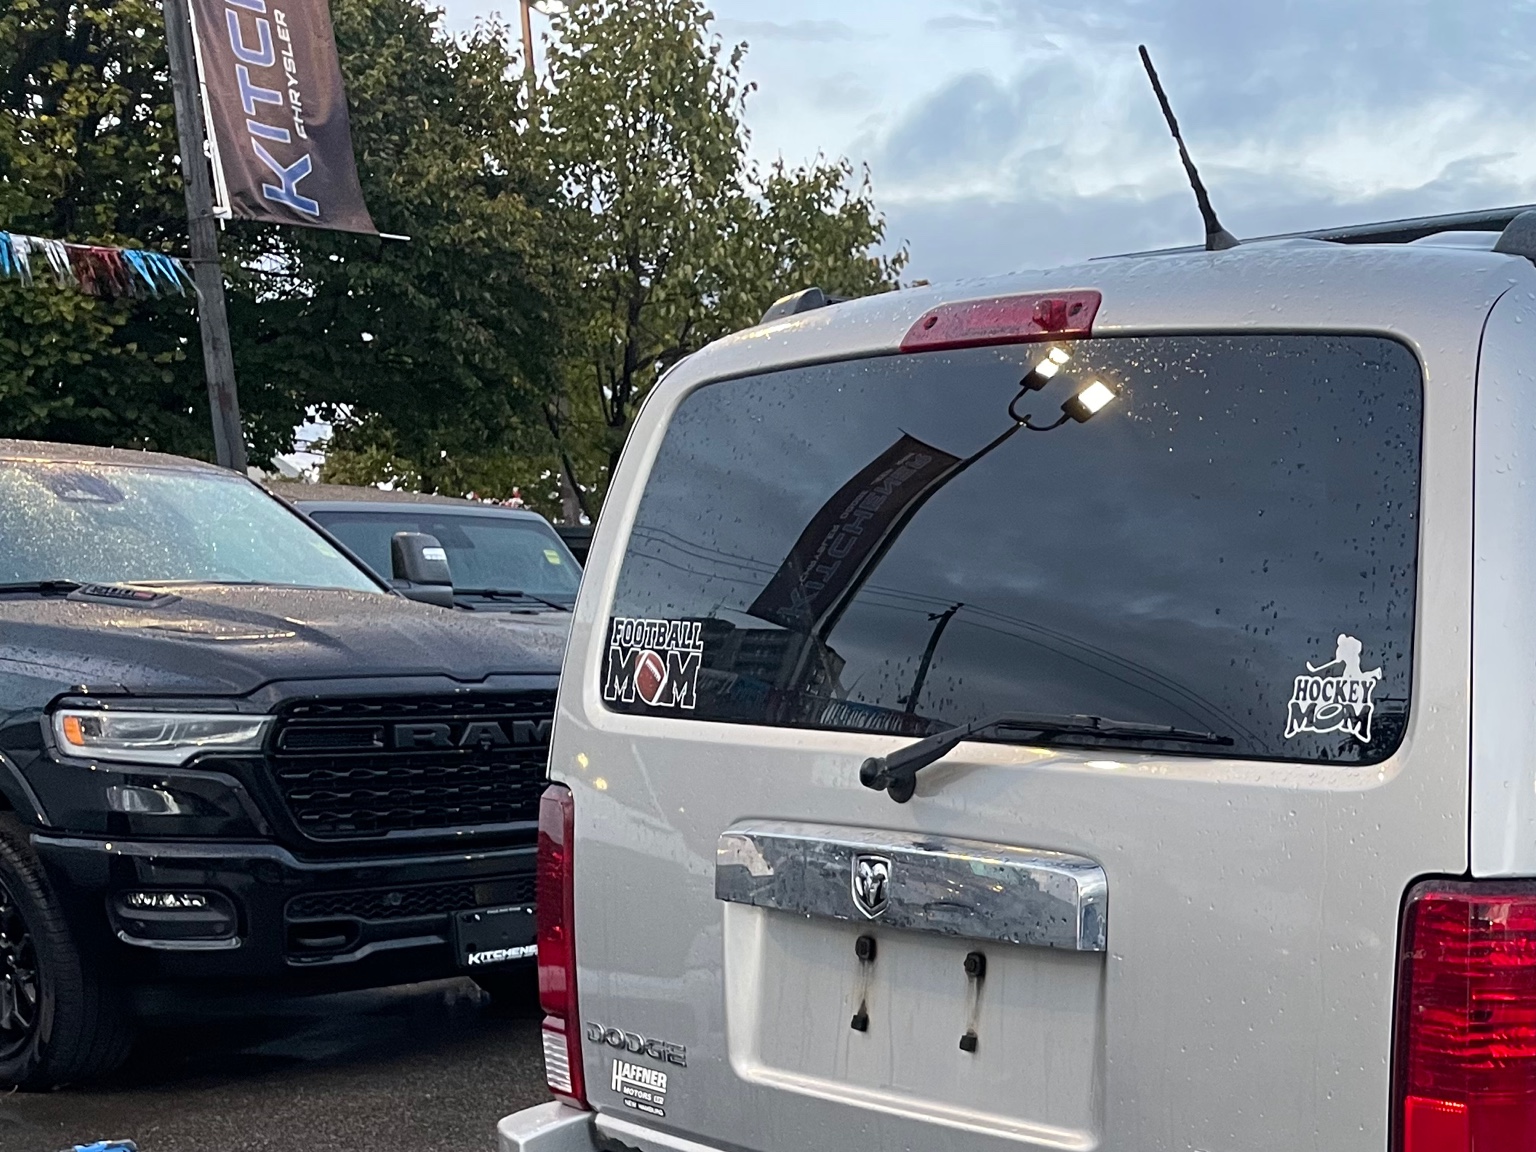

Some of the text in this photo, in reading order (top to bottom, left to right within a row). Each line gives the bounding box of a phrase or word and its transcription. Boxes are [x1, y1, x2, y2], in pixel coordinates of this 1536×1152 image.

[273, 8, 309, 140] CHRYSLER
[224, 0, 320, 217] KITC
[610, 617, 704, 653] FOOTBALL
[603, 645, 703, 709] MOM
[1293, 675, 1377, 705] HOCKEY
[394, 719, 552, 748] RAM
[1284, 700, 1375, 743] MOM
[467, 944, 538, 965] KITCHENE
[586, 1020, 688, 1068] DODGE
[611, 1058, 668, 1093] HAFFNER
[623, 1085, 652, 1101] MOTORS
